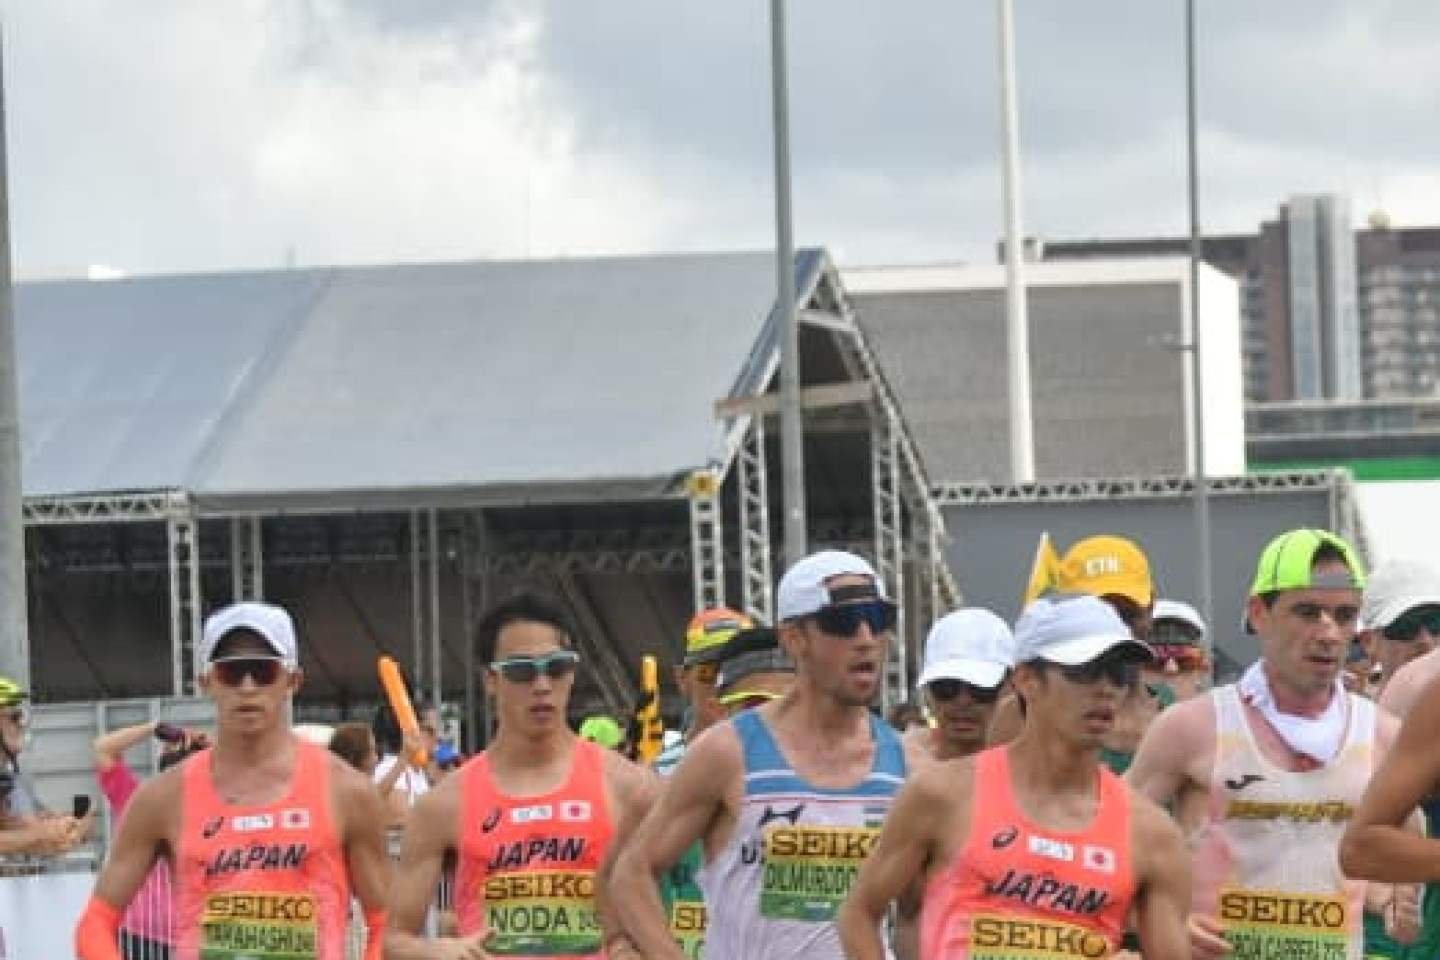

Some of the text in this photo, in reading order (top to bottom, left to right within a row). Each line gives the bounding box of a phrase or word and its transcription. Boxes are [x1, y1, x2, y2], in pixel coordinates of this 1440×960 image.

[206, 844, 307, 877] JAPAN
[488, 838, 586, 872] JAPAN
[771, 830, 880, 858] SEIK
[485, 874, 594, 900] SEIKO
[985, 869, 1107, 914] JAPAN
[205, 895, 312, 920] SEIKO
[490, 905, 571, 932] NODA
[1221, 893, 1345, 928] SEIKO
[974, 918, 1106, 958] SEIKO
